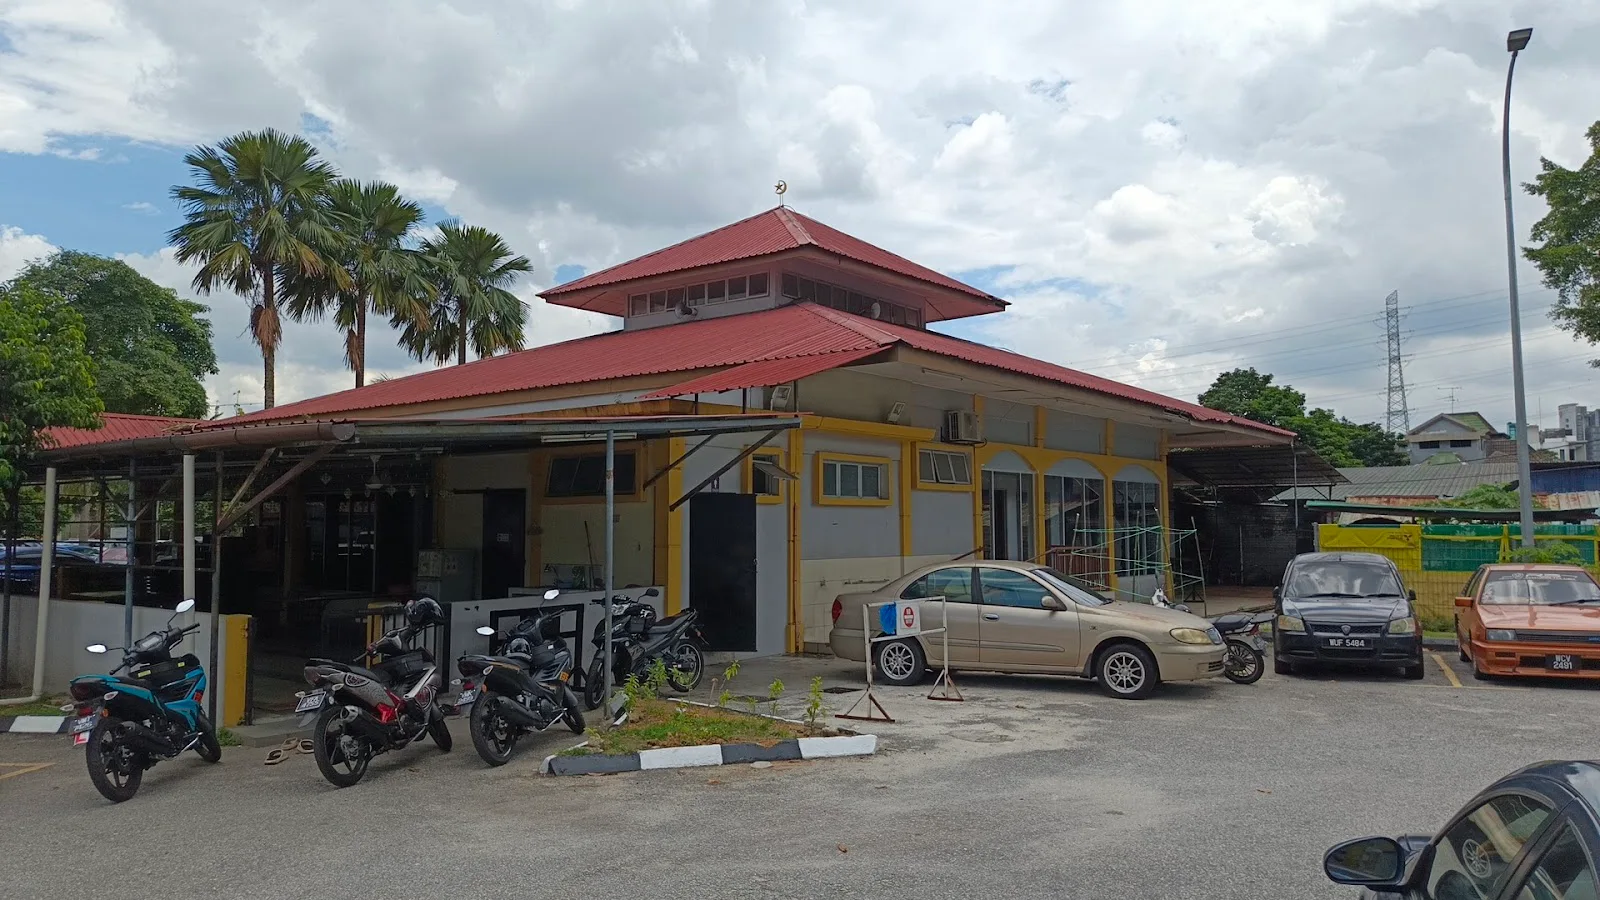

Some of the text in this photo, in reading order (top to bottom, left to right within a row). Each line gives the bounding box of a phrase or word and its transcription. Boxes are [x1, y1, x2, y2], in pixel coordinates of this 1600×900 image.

[1329, 638, 1365, 647] WUF 5484
[1555, 654, 1571, 662] WCV
[1553, 661, 1572, 669] 2491
